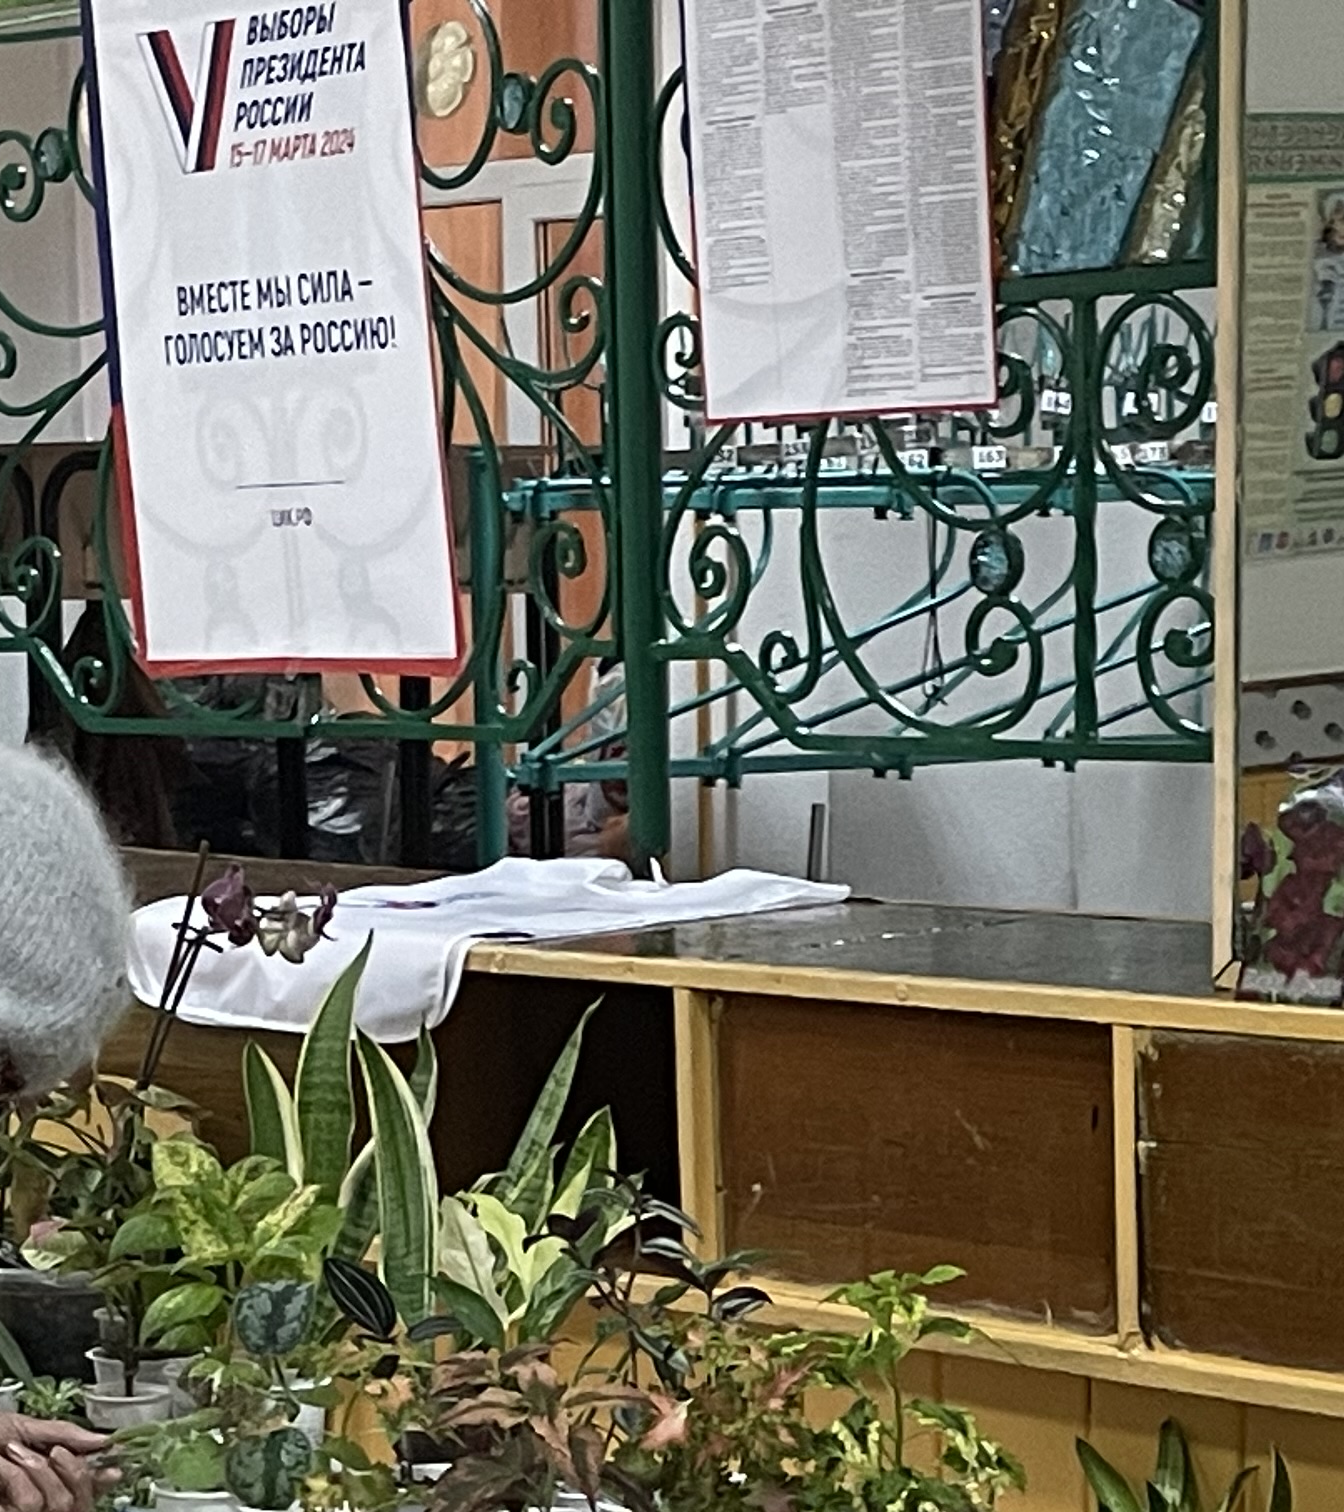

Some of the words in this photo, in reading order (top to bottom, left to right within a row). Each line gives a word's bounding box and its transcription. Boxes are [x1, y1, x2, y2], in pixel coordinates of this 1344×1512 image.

[246, 1, 336, 46] ВЫБОРЫ
[239, 39, 366, 90] ПРЕЗИДЕНТА
[232, 91, 314, 133] РОССИИ
[268, 132, 317, 164] МАРТА
[319, 127, 356, 158] 2024
[176, 279, 252, 317] ВМЕСТЕ
[256, 274, 293, 310] МЫ
[297, 268, 354, 306] СИЛА
[163, 325, 266, 367] ГОЛОСУЕМ
[268, 324, 296, 358] ЗА
[299, 314, 398, 356] РОССИЮ!
